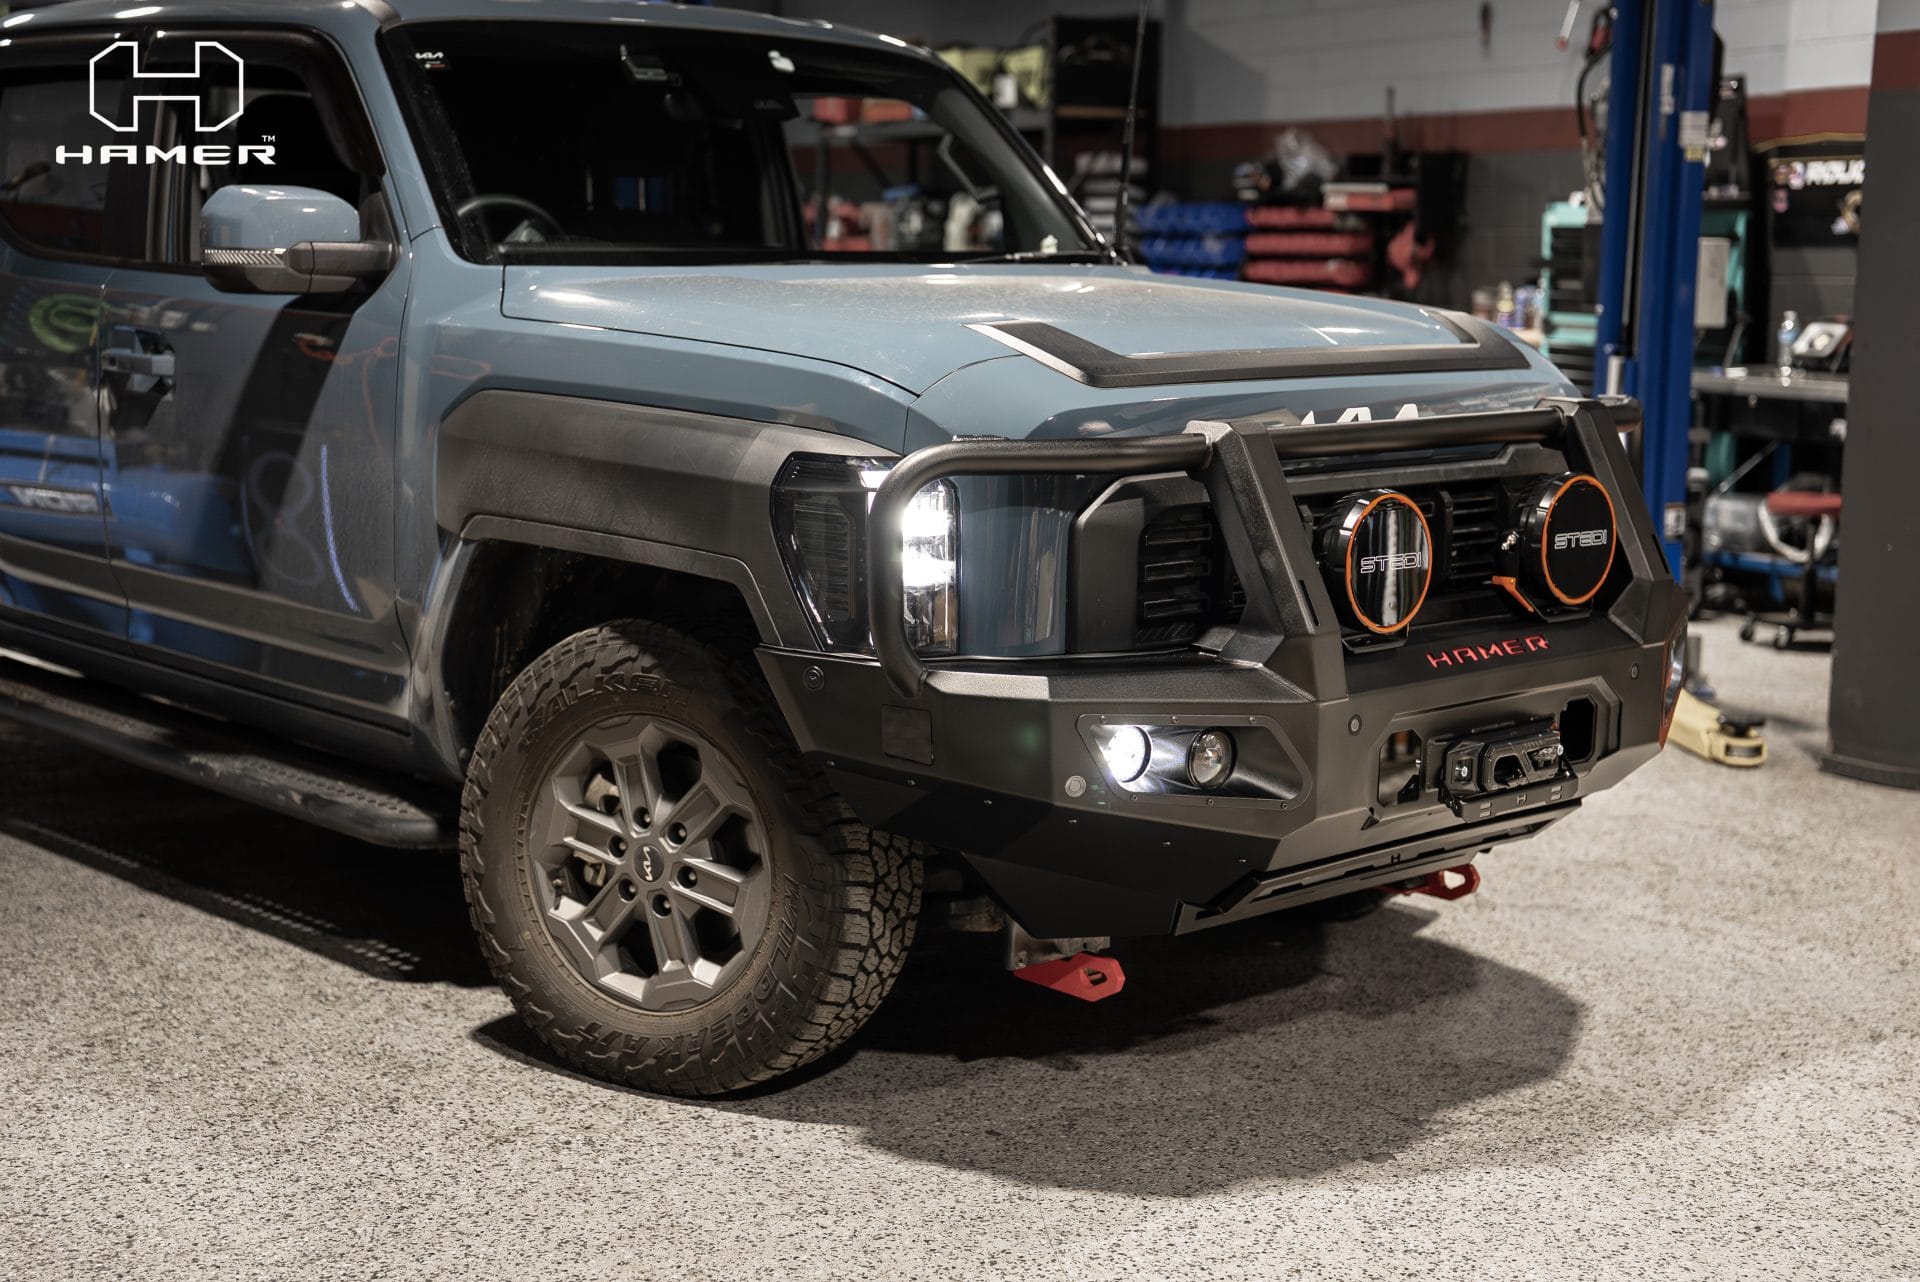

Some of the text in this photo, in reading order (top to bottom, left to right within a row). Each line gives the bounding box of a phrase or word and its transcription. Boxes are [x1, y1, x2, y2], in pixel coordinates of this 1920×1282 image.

[1554, 529, 1607, 550] STEDI
[1360, 551, 1422, 574] STEDI
[1426, 634, 1551, 669] HAMER
